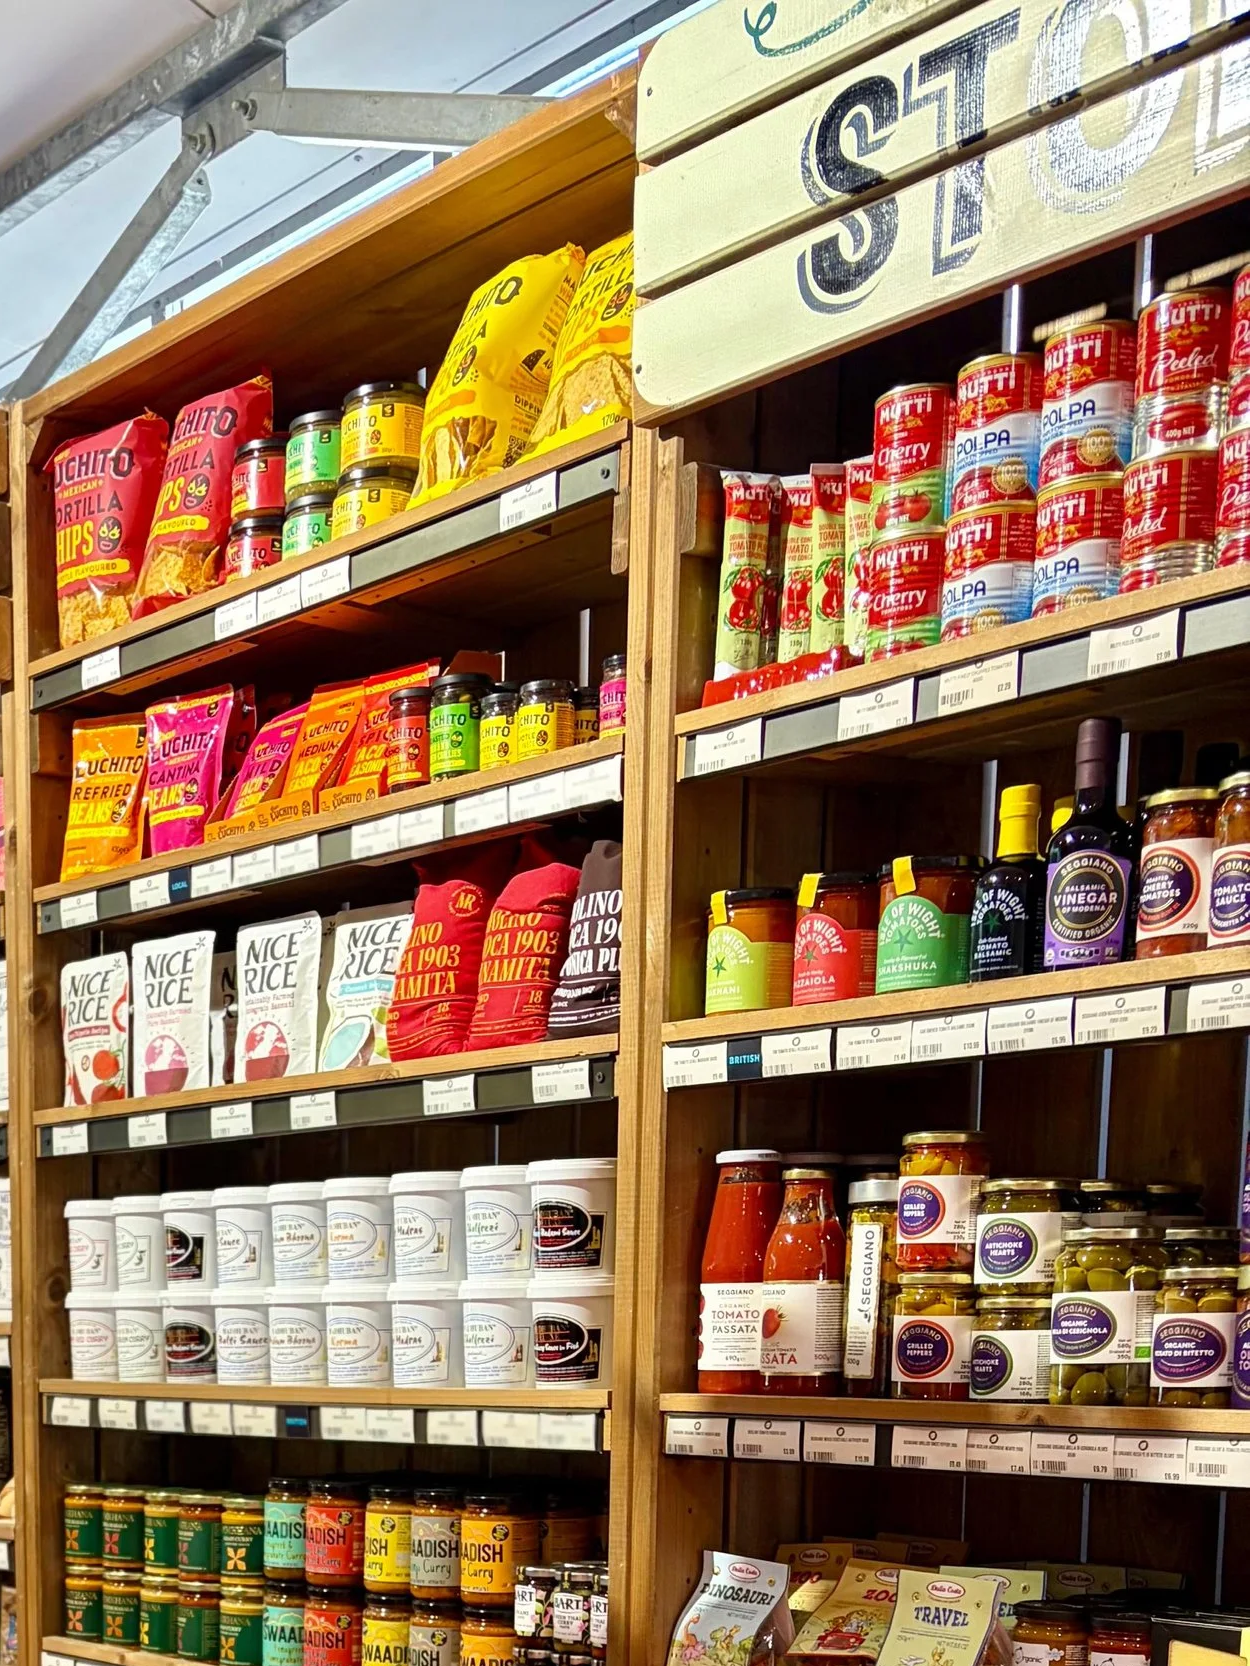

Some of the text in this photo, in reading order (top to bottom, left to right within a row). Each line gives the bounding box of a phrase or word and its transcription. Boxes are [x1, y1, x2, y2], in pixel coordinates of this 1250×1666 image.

[1155, 304, 1221, 328] MUTTI
[1044, 339, 1102, 371] MUTTI
[1150, 344, 1219, 388] Peeled
[958, 372, 1016, 400] MUTTI
[880, 397, 932, 424] MUTTI
[1042, 399, 1096, 428] POLPA
[878, 442, 930, 467] Cherry
[957, 429, 1010, 458] POLPA
[55, 448, 133, 491] UCHITO
[1124, 467, 1168, 494] MUTTI
[62, 481, 98, 499] MEXICAN
[876, 545, 928, 572] MUTTI
[873, 589, 926, 612] Cherry
[75, 755, 143, 778] LUCHITO
[149, 761, 199, 785] CANTINA
[74, 784, 131, 800] REFRIED
[70, 800, 111, 824] BEANS
[1061, 855, 1114, 877] SEGGIANO
[171, 882, 187, 890] LOCAL
[1065, 884, 1106, 892] BALSAMIC
[1139, 888, 1181, 903] TOMATOES
[1143, 880, 1174, 893] CHERRY
[997, 888, 1027, 920] WIGHT
[1054, 892, 1118, 907] VINEGAR
[1072, 906, 1105, 914] MODENA
[1216, 893, 1246, 907] SAUCE
[885, 916, 926, 946] TOMATOES
[892, 901, 941, 938] OF WIGHT
[1085, 914, 1116, 938] ORGANIC
[347, 917, 409, 953] NICE
[513, 929, 560, 955] 1903
[814, 920, 842, 953] WIGHT
[977, 942, 1008, 951] TOMATO
[245, 931, 304, 966] NICE
[417, 945, 461, 970] 1903
[974, 949, 1012, 960] BALSAMIC
[145, 948, 198, 980] NICE
[339, 947, 396, 981] RICE
[878, 961, 937, 977] SHAKSHUKA
[68, 969, 114, 998] NICE
[244, 961, 298, 996] RICE
[145, 977, 194, 1009] RICE
[529, 990, 543, 1003] 18
[68, 995, 110, 1026] RICE
[729, 1053, 760, 1065] BRITISH
[985, 1225, 1025, 1240] SEGGIANO
[985, 1241, 1023, 1249] ARTICHOKE
[861, 1230, 875, 1305] SEGGIANO
[711, 1309, 760, 1320] TOMATO
[1057, 1305, 1097, 1316] SEGGIANO
[712, 1325, 758, 1334] PASSATA
[902, 1326, 941, 1341] SEGGIANO
[1068, 1327, 1108, 1335] CERIGNOLA
[1159, 1327, 1206, 1339] SEGGIANO
[906, 1349, 933, 1357] PEPPERS
[907, 1342, 933, 1350] GRILLED
[423, 1559, 451, 1579] Curry
[468, 1563, 494, 1583] Curry
[555, 1598, 581, 1610] BART
[700, 1583, 775, 1606] DINOSAURI
[914, 1606, 969, 1627] TRAVEL
